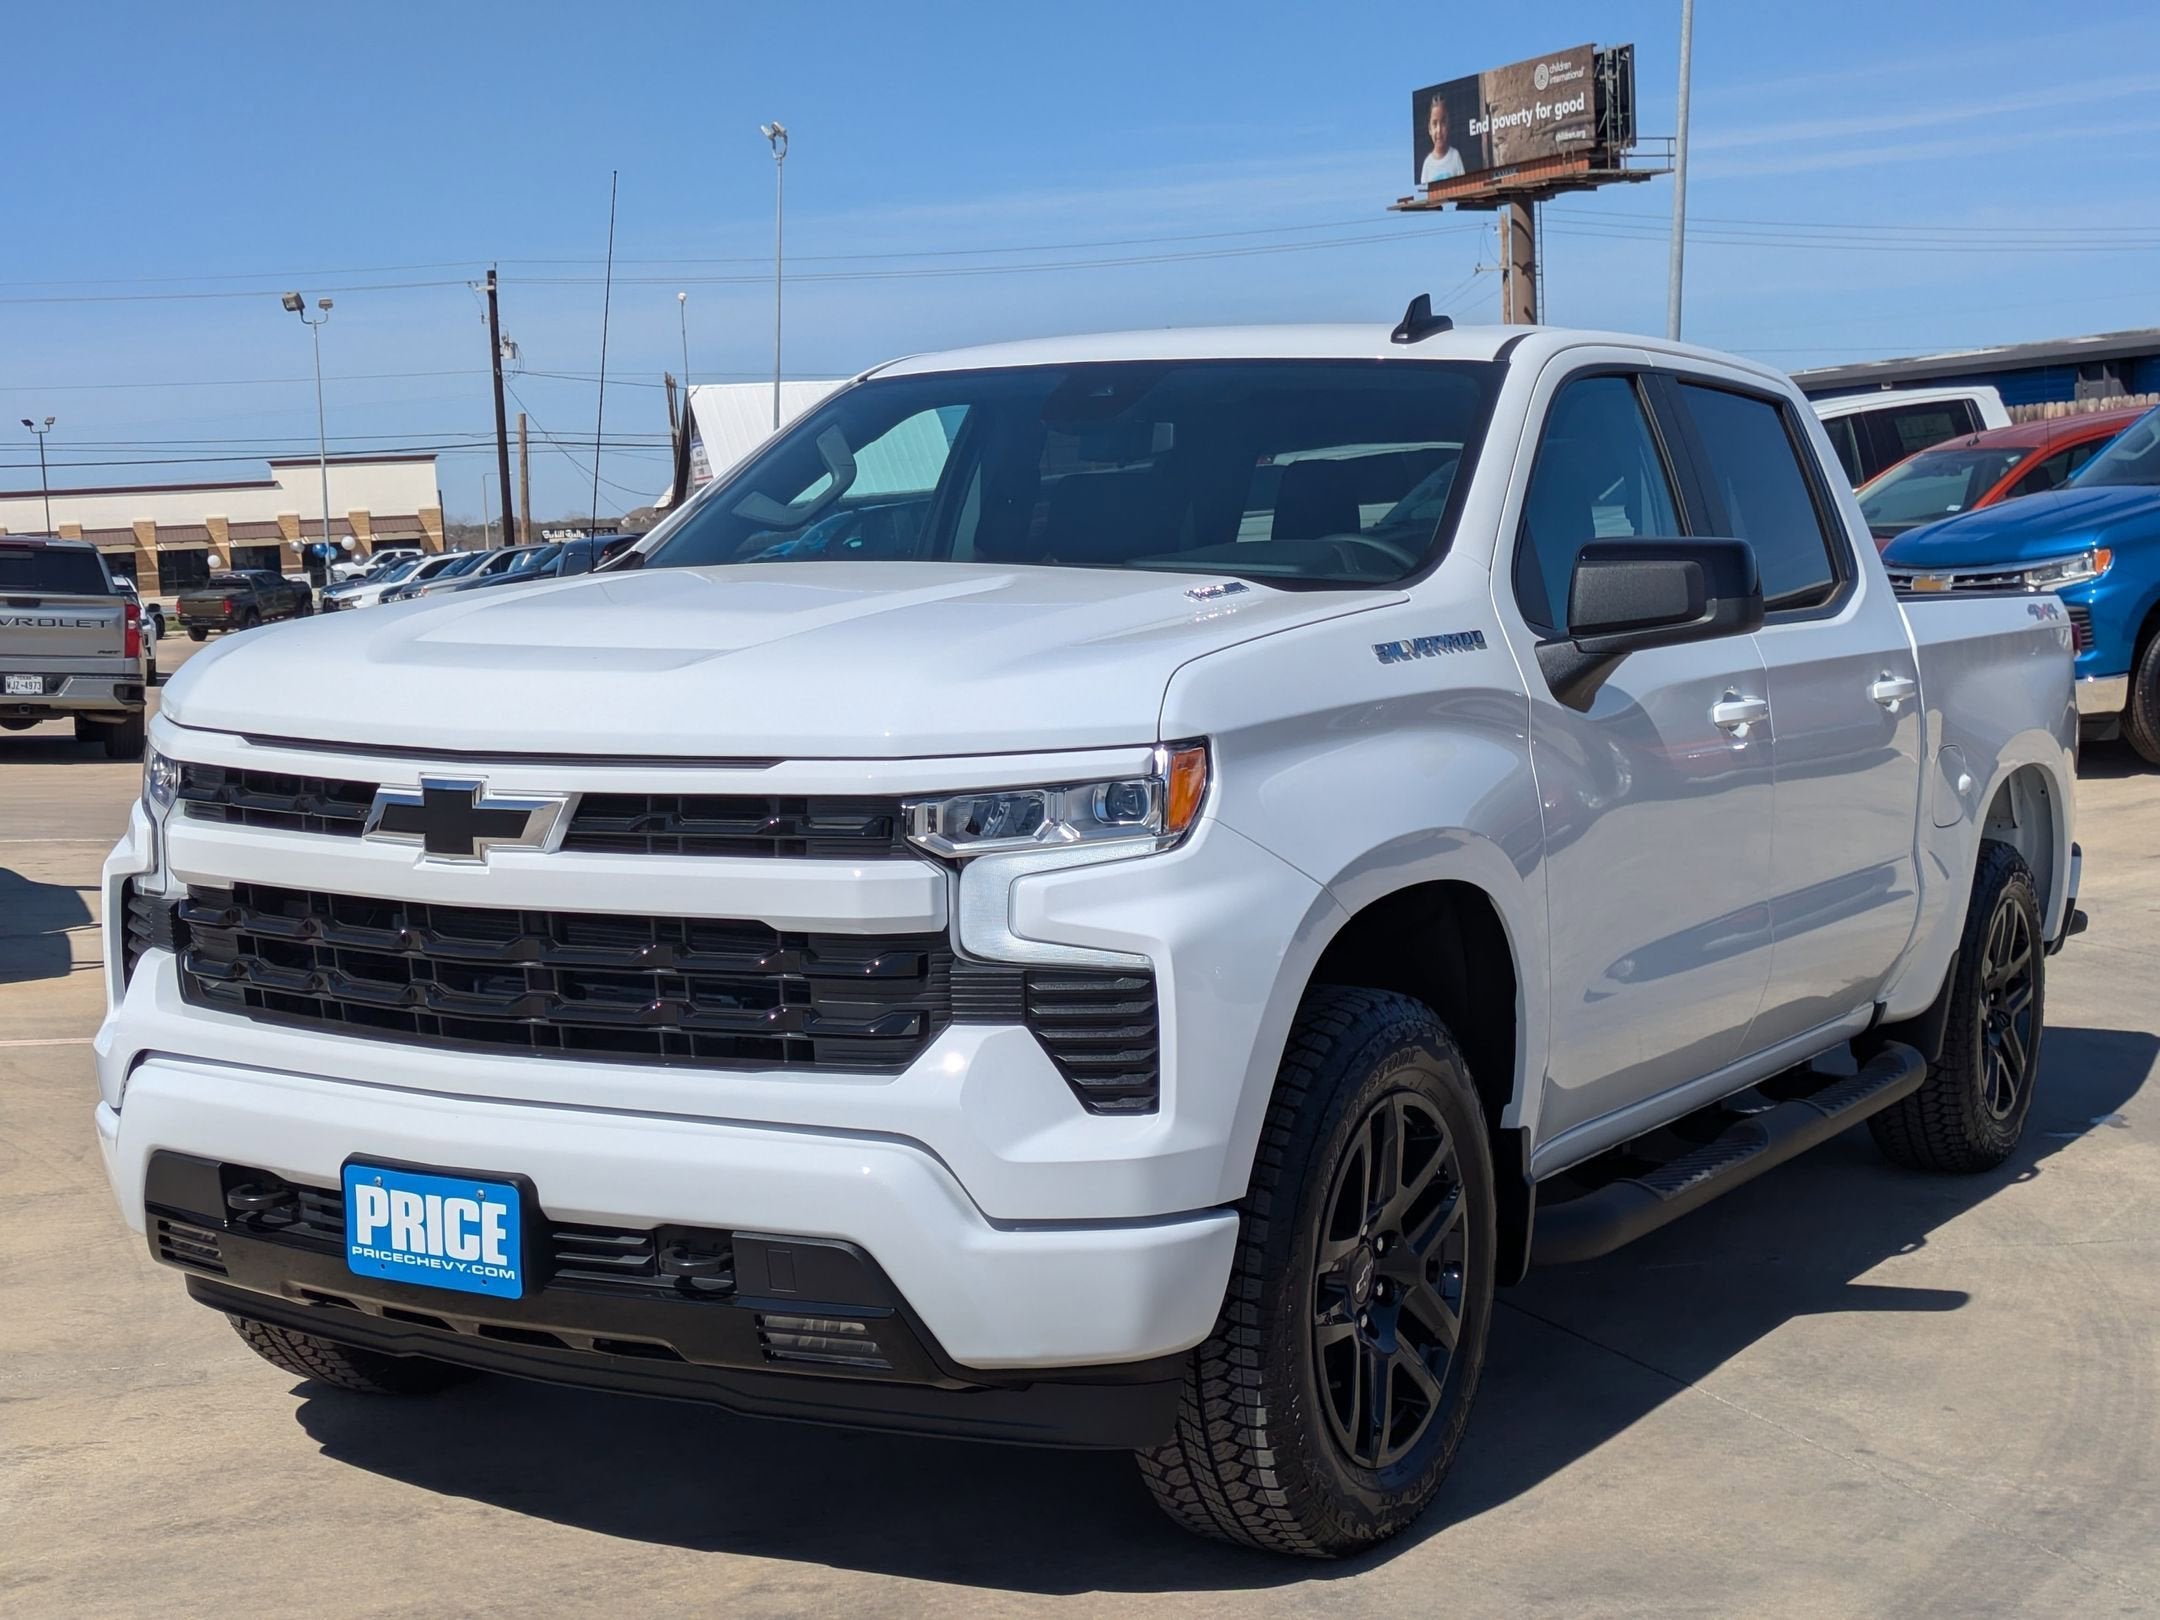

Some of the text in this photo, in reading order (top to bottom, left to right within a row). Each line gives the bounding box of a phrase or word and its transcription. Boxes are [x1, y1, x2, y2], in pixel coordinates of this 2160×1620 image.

[1549, 61, 1572, 74] children
[1469, 92, 1585, 136] End poverty for good
[355, 1183, 508, 1266] PRICE
[352, 1245, 516, 1281] PRICECHEVY.COM
